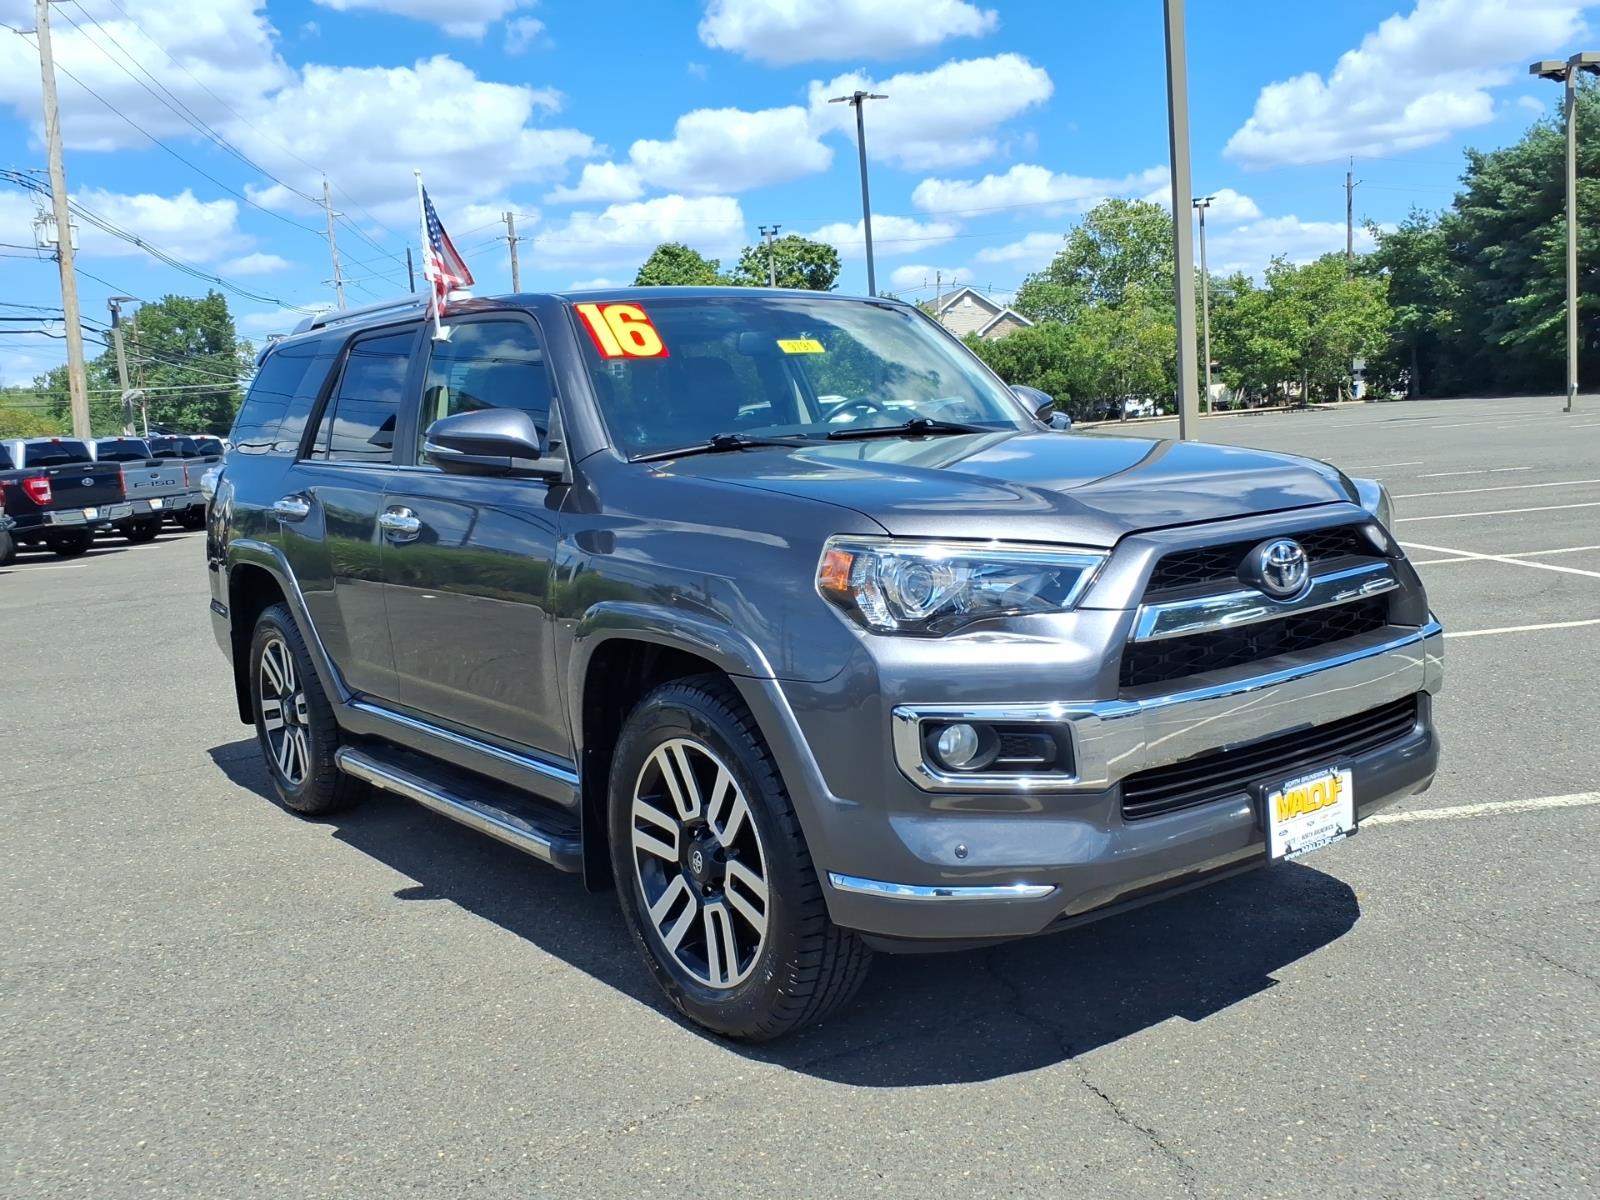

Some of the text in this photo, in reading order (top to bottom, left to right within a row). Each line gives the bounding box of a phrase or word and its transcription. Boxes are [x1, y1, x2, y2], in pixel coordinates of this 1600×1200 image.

[575, 303, 664, 358] 16
[134, 479, 176, 488] F-150
[1276, 776, 1343, 823] MALOUF
